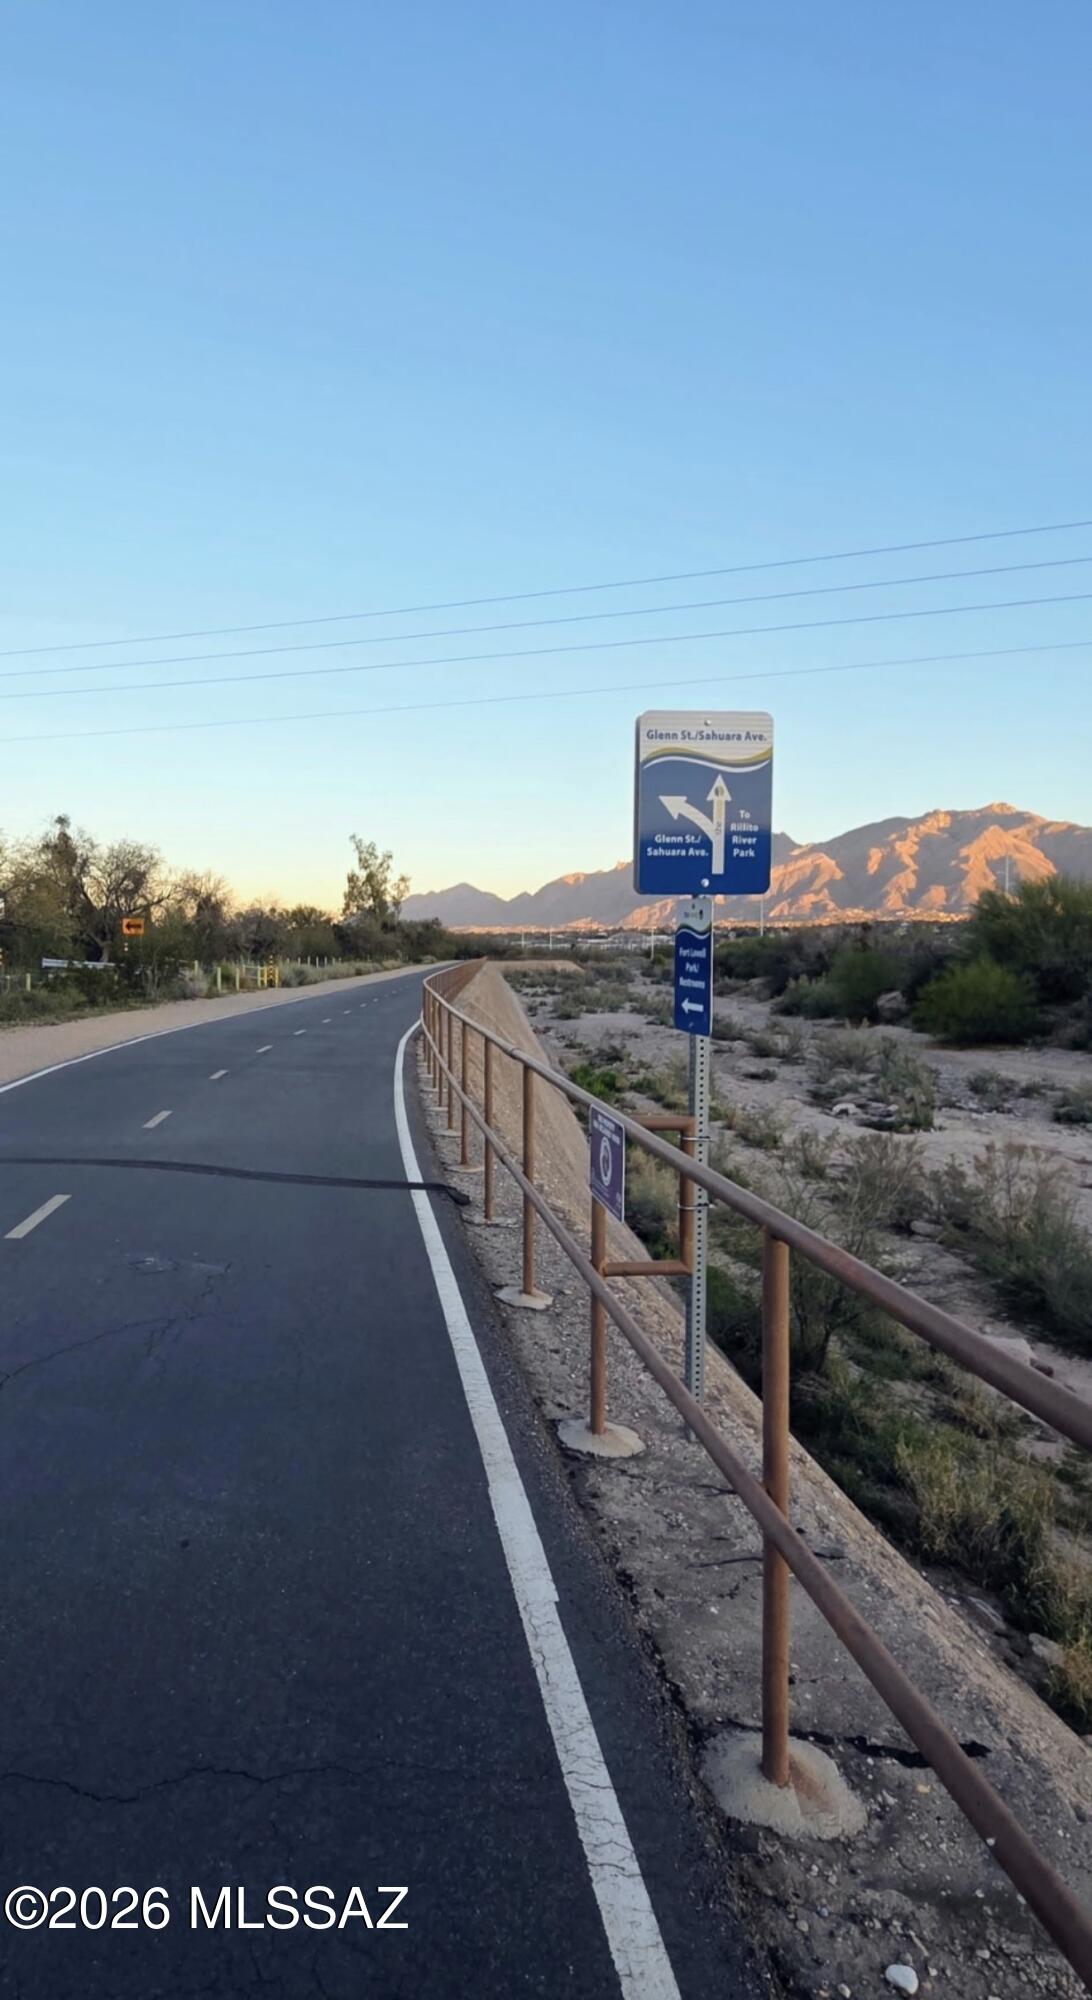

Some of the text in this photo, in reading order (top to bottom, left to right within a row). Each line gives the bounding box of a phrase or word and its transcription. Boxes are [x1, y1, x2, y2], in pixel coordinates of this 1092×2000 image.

[646, 729, 767, 741] Glenn St./Sahuara Ave.
[739, 810, 750, 819] To
[730, 823, 759, 832] Rillito
[655, 834, 683, 844] Glenn
[732, 835, 757, 845] River
[647, 847, 708, 857] Sahuara Ave.
[733, 848, 755, 858] Park
